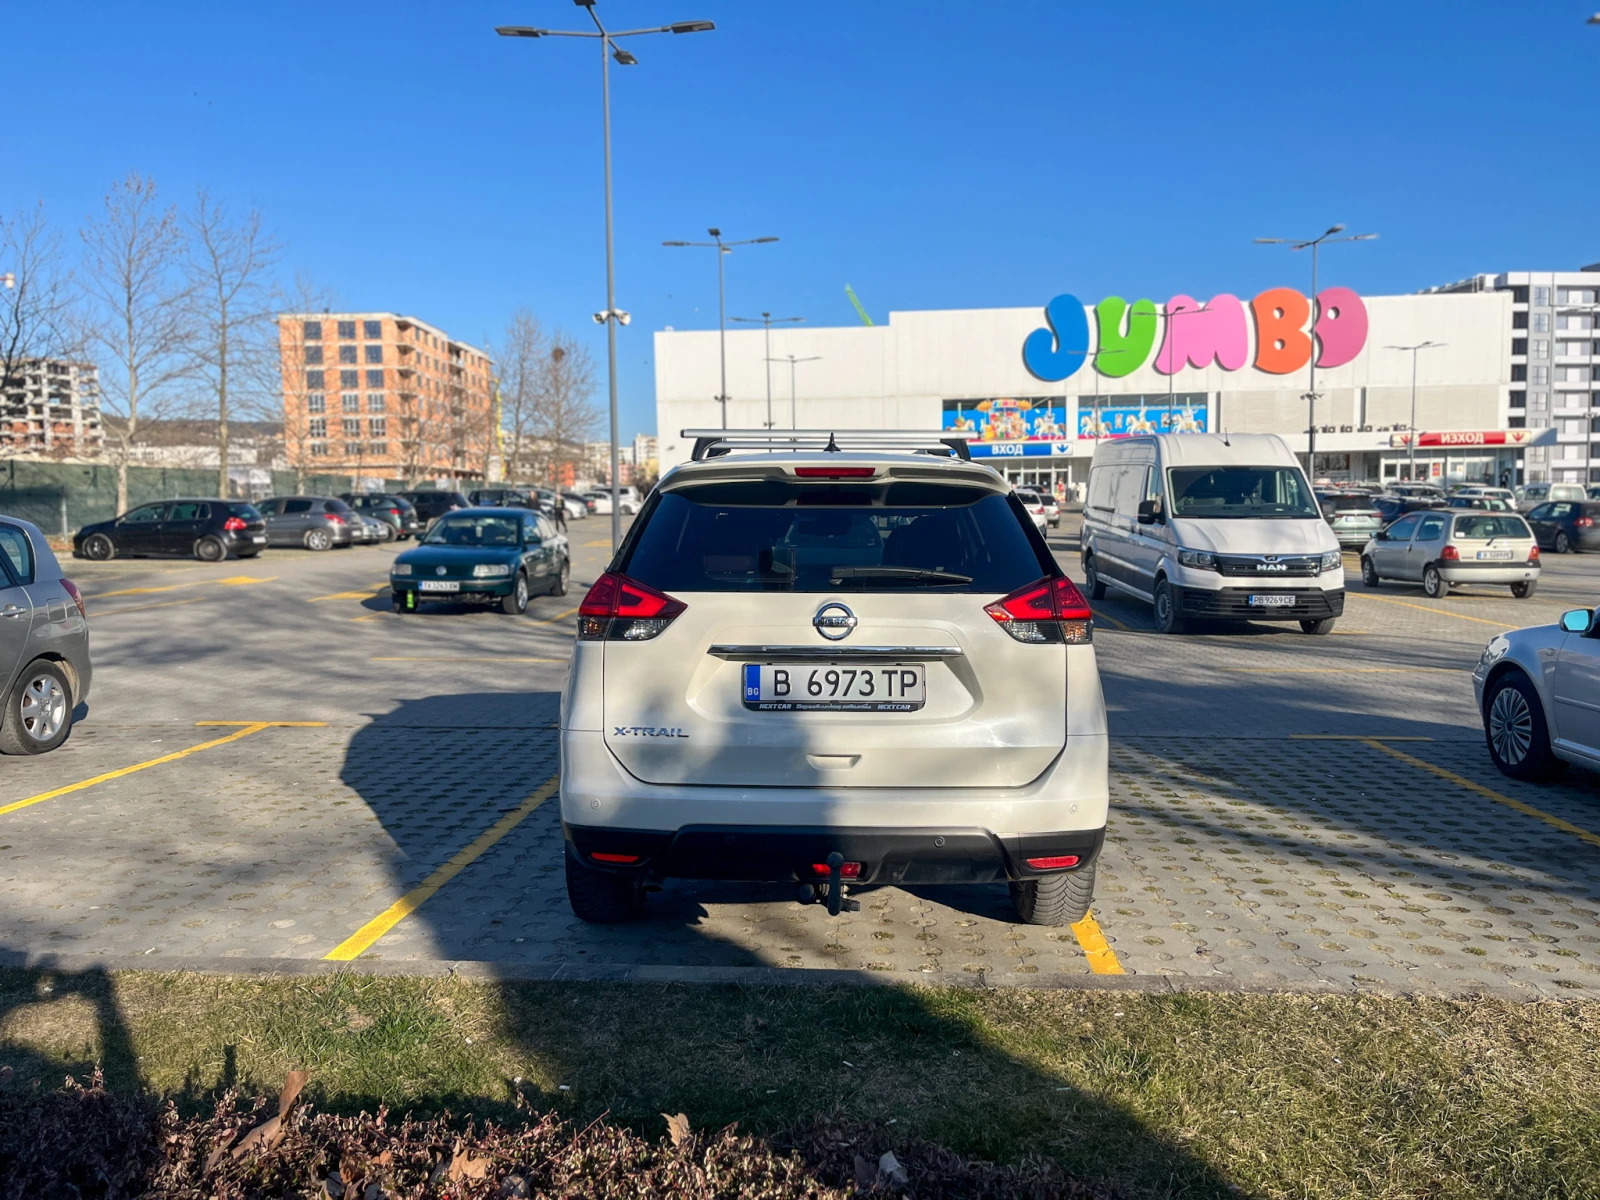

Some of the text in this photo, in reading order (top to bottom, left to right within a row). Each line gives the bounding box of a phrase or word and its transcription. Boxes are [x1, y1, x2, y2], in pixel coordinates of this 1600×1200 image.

[1023, 286, 1369, 382] JUMBO
[1441, 432, 1485, 444] ИЗХОД
[992, 444, 1023, 456] ВХОД
[1254, 596, 1294, 604] PB 9269 CE
[774, 669, 918, 697] B 6973 TP
[747, 687, 759, 696] BG
[613, 727, 690, 738] X-TRAIL
